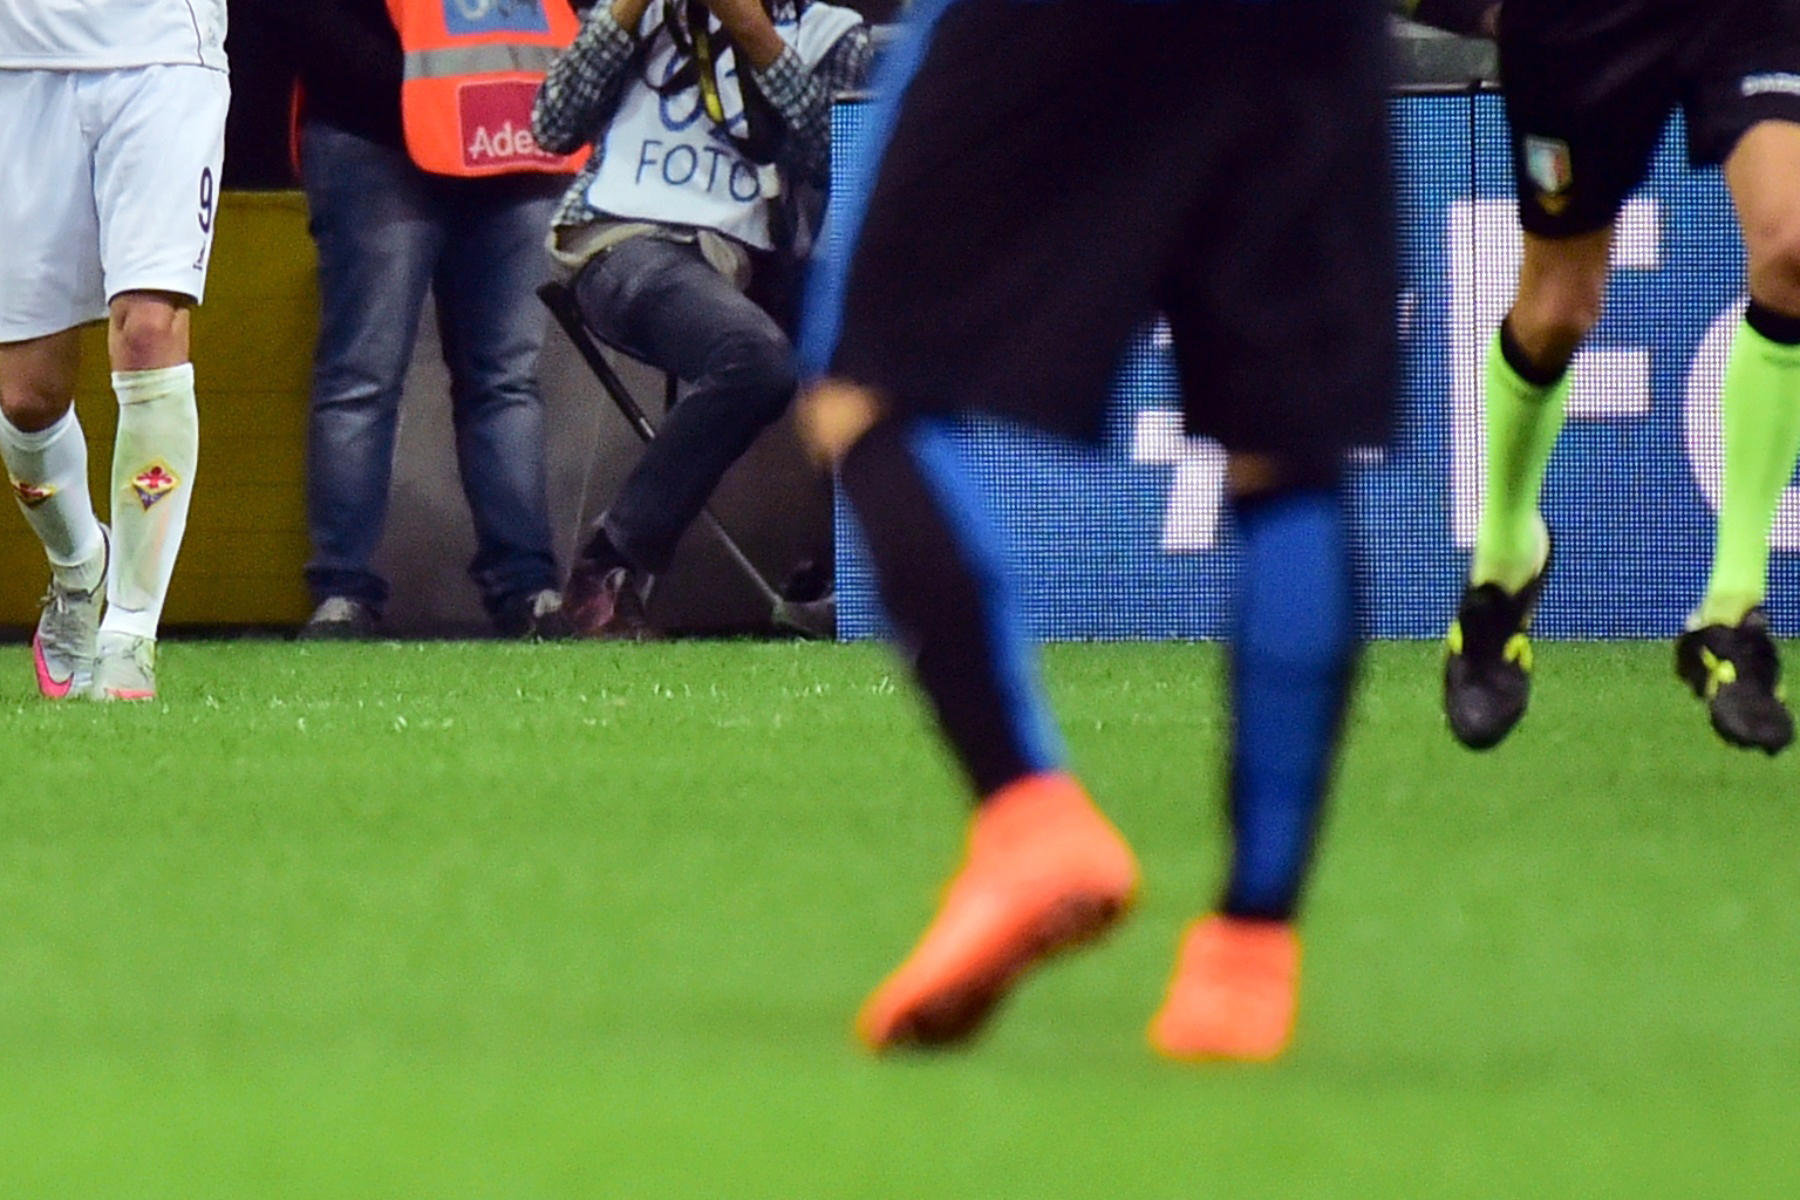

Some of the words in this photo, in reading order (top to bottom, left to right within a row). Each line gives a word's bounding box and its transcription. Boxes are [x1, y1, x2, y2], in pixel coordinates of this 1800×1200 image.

[468, 120, 555, 159] Ade
[635, 139, 760, 202] FOTO
[198, 166, 213, 234] 9
